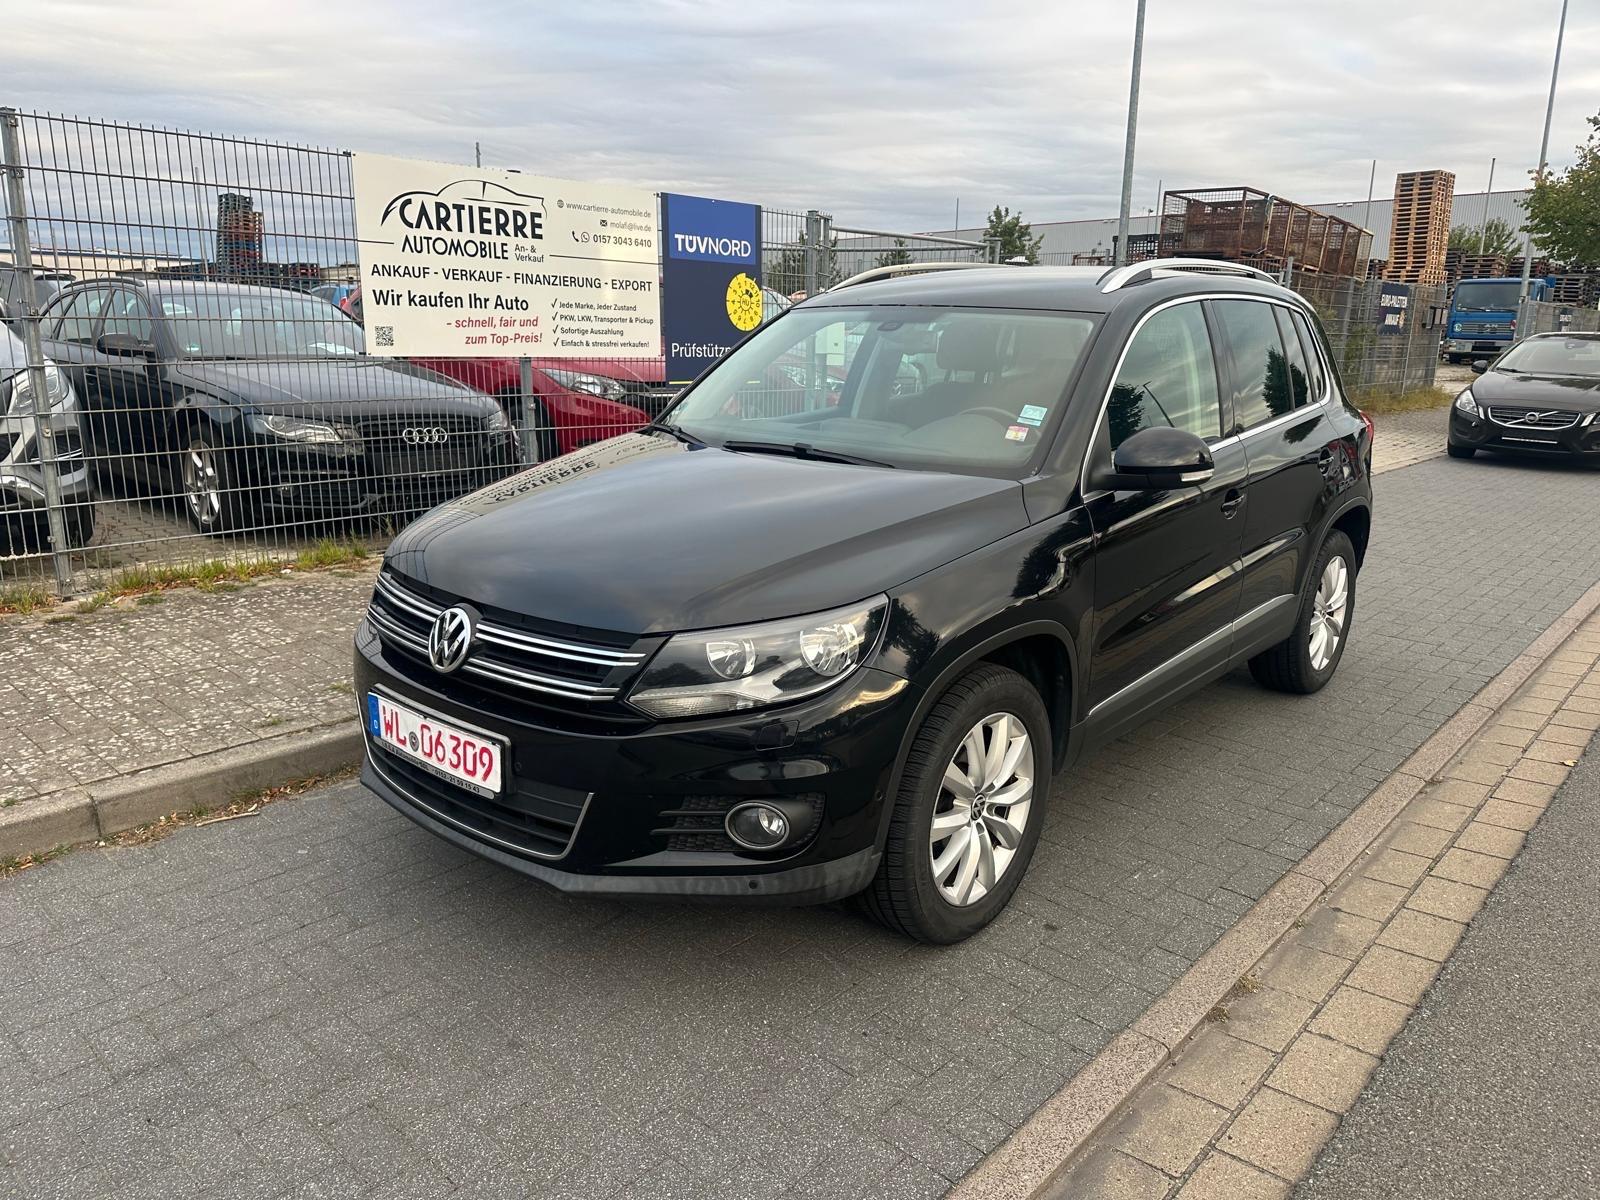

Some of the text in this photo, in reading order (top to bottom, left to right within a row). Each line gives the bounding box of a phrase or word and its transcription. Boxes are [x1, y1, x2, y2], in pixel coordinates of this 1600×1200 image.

[566, 202, 651, 218] www.cartierre-automobile.de
[399, 198, 543, 240] CARTIERRE
[401, 234, 509, 260] AUTOMOBILE
[593, 234, 652, 248] 0157 3043 6410
[514, 243, 528, 253] An-
[514, 253, 544, 263] Verkauf
[371, 264, 430, 279] ANKAUF
[442, 267, 503, 283] VERKAUF
[514, 272, 601, 289] FINANZIERUNG
[611, 279, 653, 291] EXPORT
[372, 289, 529, 311] Wir kaufen Ihr Auto
[575, 302, 595, 310] Marke,
[455, 317, 497, 329] schnell,
[499, 317, 516, 328] fair
[520, 317, 539, 327] und
[560, 314, 576, 322] PKW,
[594, 315, 627, 324] Transporter
[634, 317, 654, 325] Pickup
[560, 327, 624, 336] Sofortige Auszahlung
[465, 333, 543, 346] zum Top-Preis!
[382, 705, 407, 747] WL
[420, 724, 493, 782] 06309
